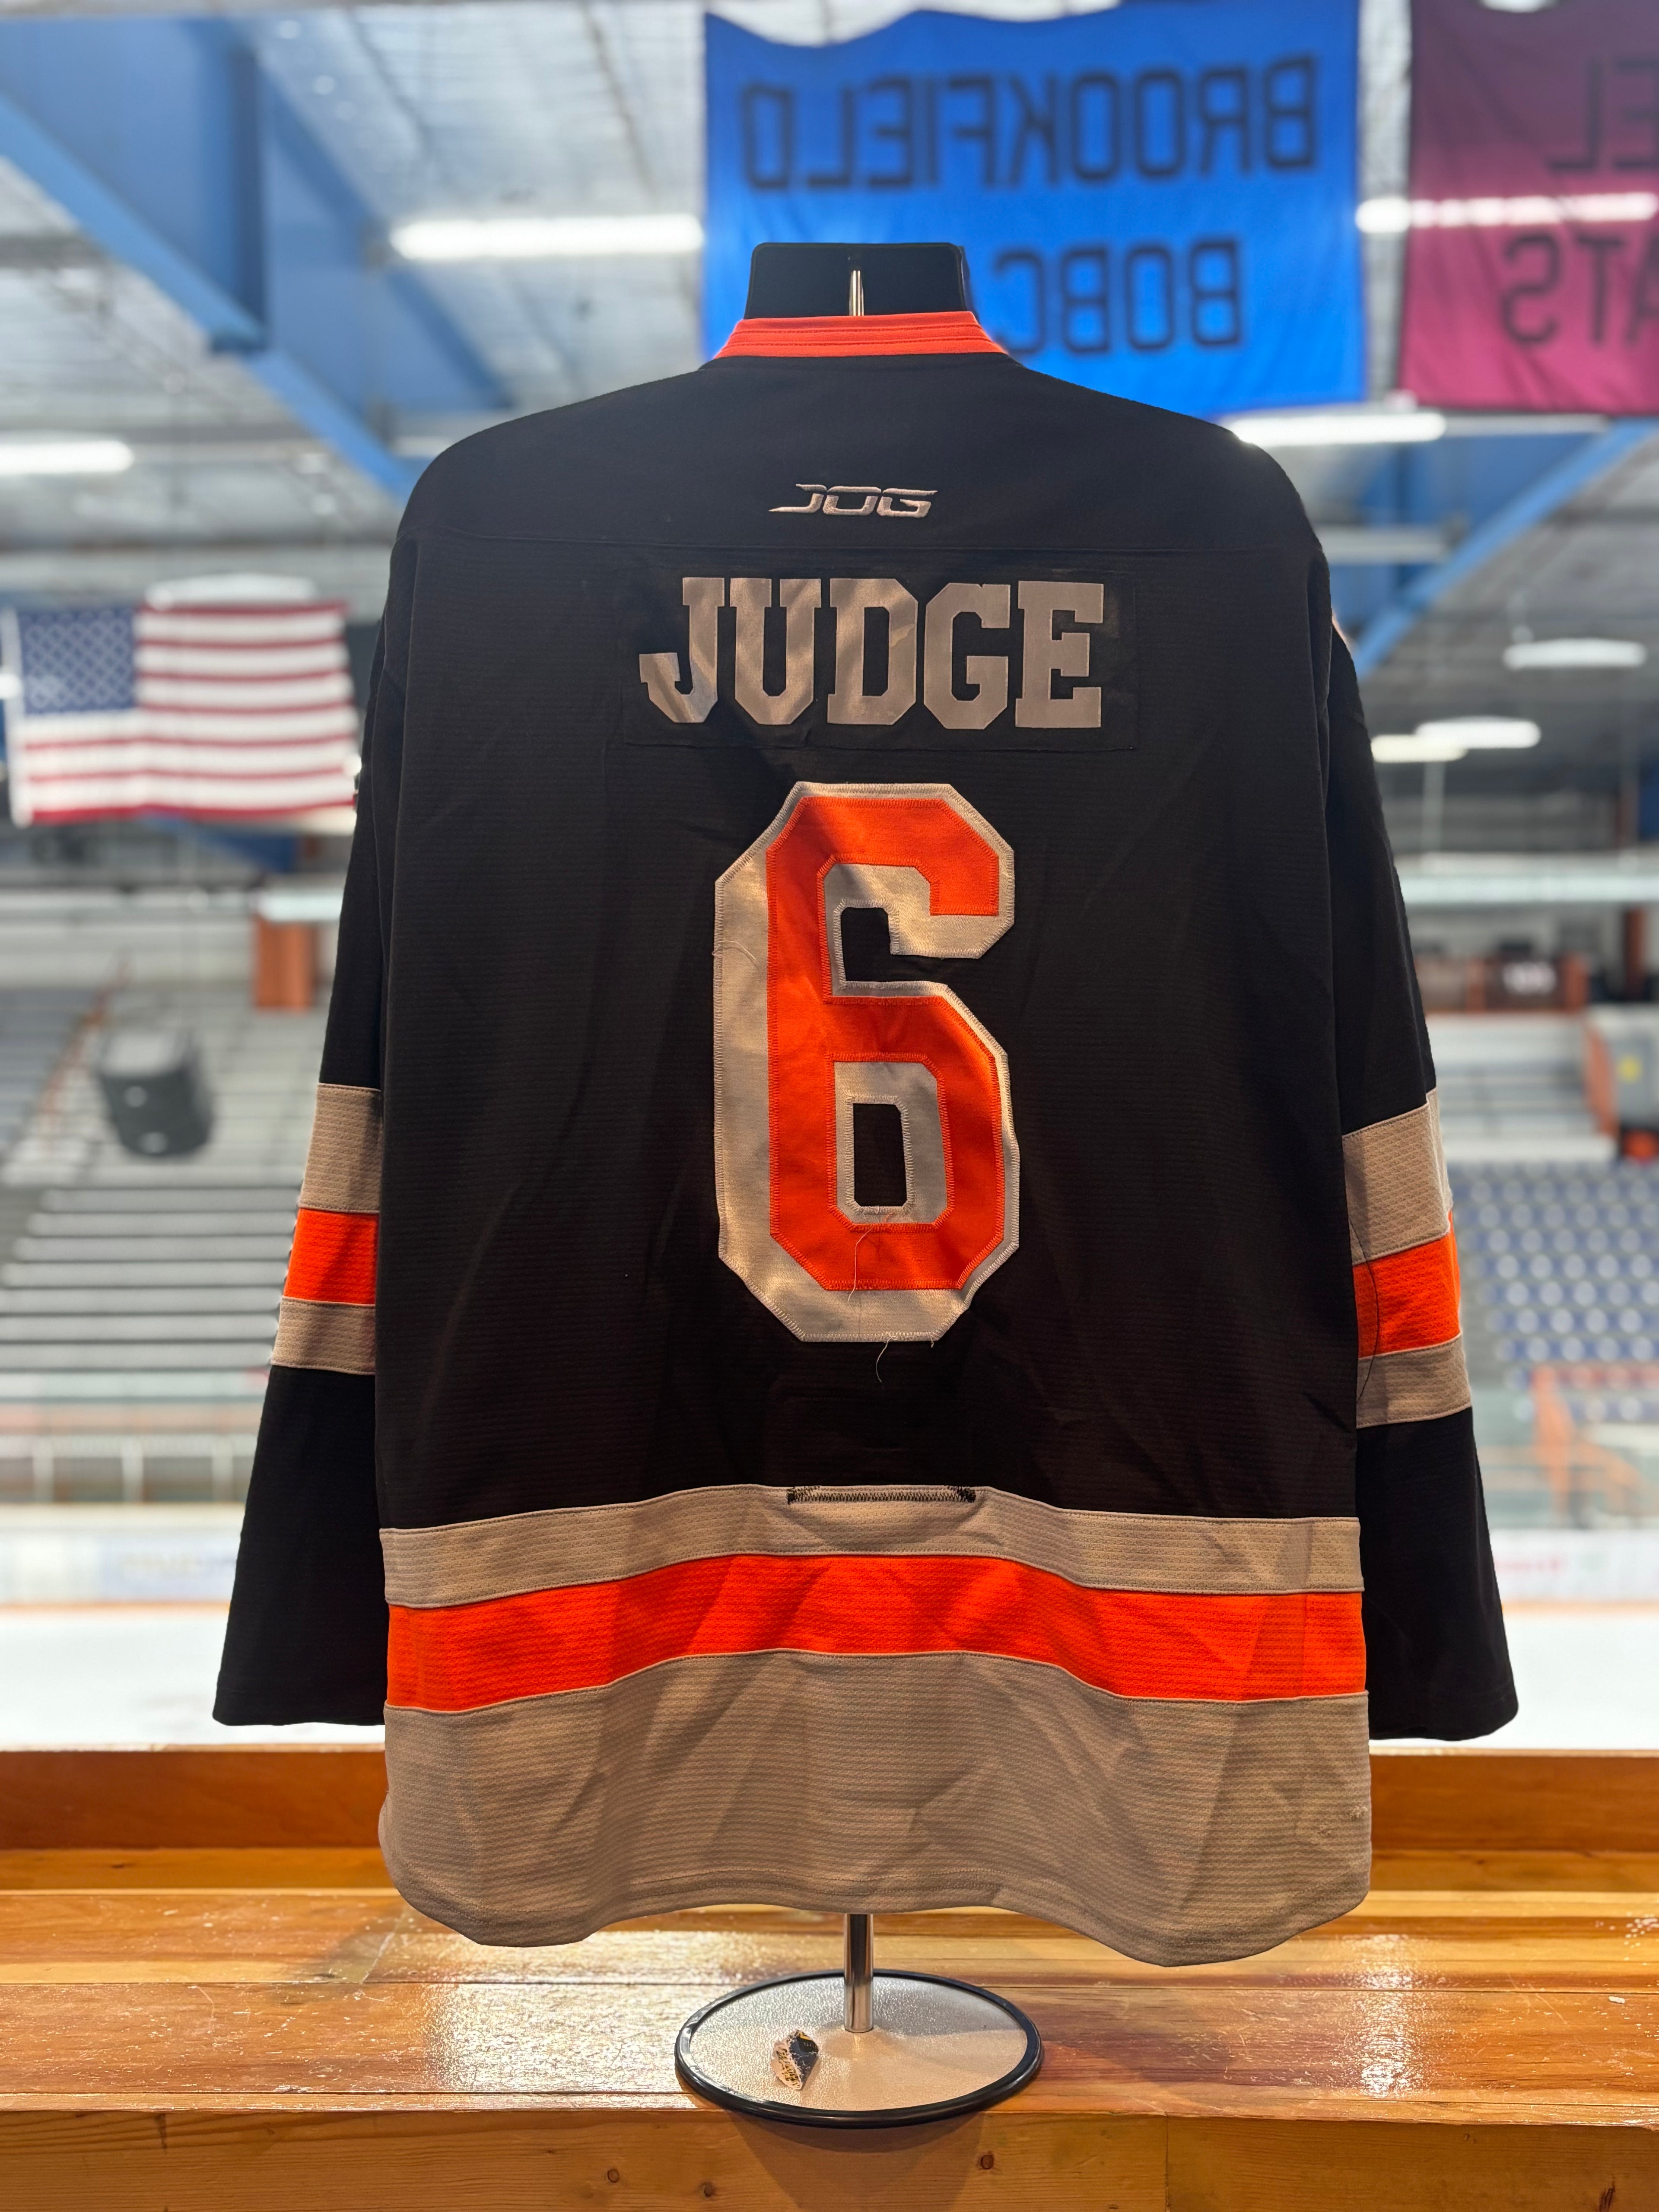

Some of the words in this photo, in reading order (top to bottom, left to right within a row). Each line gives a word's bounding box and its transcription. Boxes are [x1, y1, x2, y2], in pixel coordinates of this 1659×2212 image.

[769, 483, 938, 518] JOG
[639, 577, 1104, 730] JUDGE
[713, 781, 1020, 1342] 6
